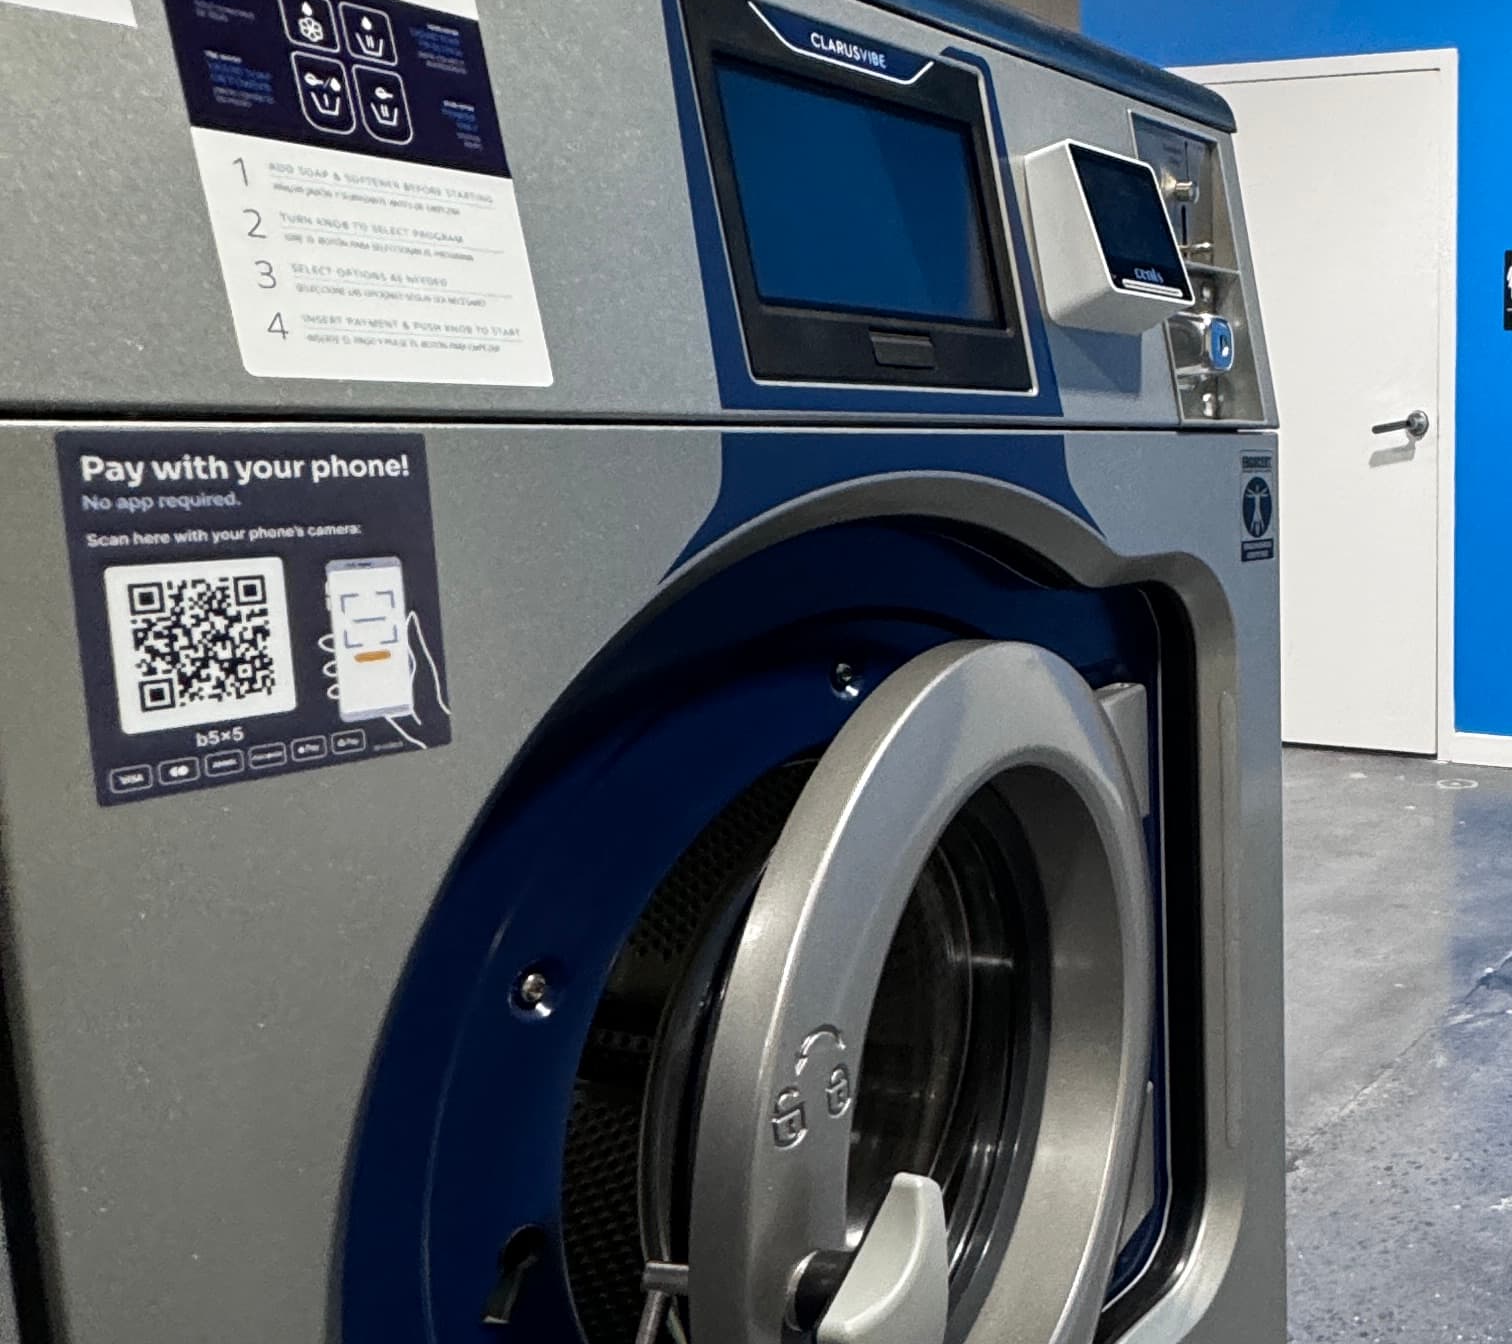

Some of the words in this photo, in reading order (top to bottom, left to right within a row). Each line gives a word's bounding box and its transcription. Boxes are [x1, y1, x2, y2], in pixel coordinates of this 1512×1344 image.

[810, 31, 887, 69] CLARUSVIBE
[233, 157, 248, 186] 1
[243, 209, 267, 239] 2
[255, 260, 276, 288] 3
[291, 263, 332, 276] SELECT
[267, 312, 288, 340] 4
[476, 325, 489, 336] TO
[491, 326, 520, 337] START
[79, 454, 145, 487] Pay
[151, 453, 229, 481] with
[234, 458, 305, 485] your
[311, 454, 410, 484] phone!
[81, 494, 111, 510] No
[116, 496, 154, 513] app
[158, 491, 242, 511] required.
[86, 532, 129, 547] Scan
[133, 530, 170, 545] here
[174, 528, 208, 544] with
[212, 529, 246, 544] your
[249, 525, 304, 542] phone's
